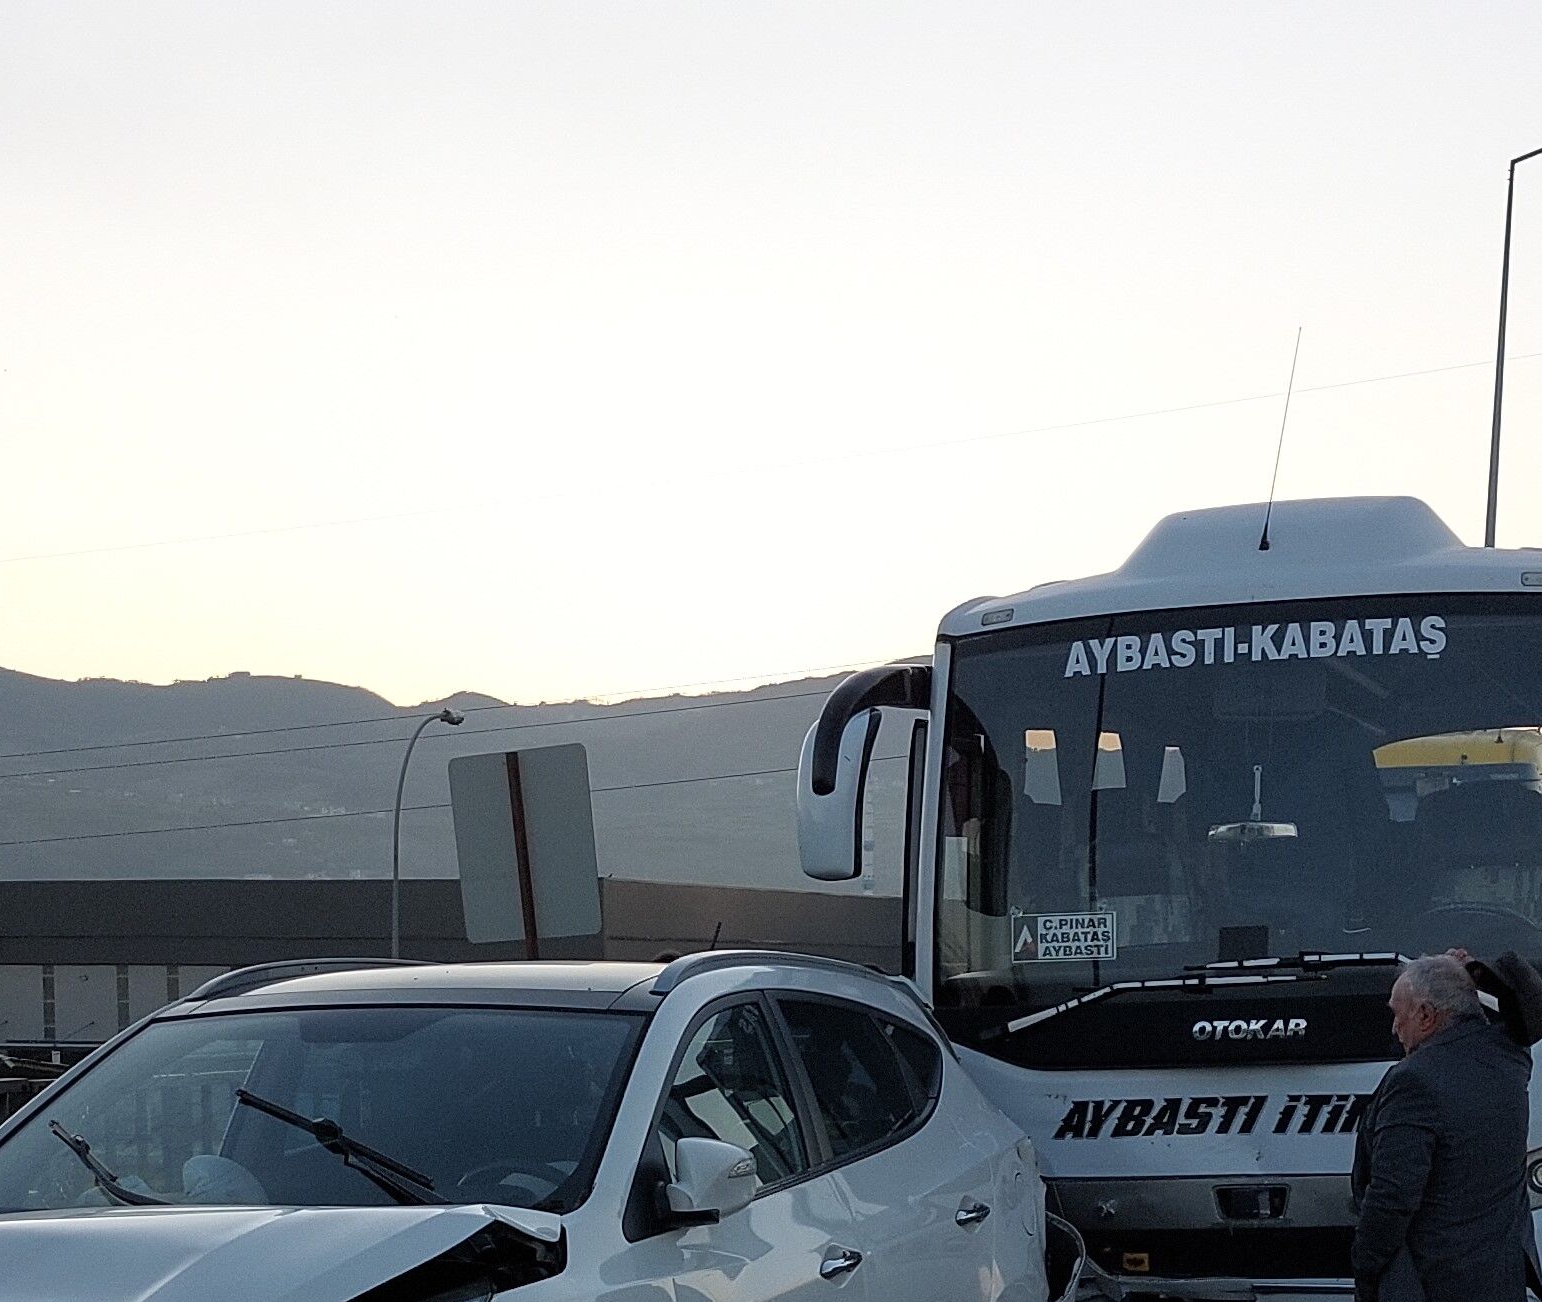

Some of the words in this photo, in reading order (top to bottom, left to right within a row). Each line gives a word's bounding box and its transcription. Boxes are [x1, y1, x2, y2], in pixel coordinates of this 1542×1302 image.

[1064, 615, 1448, 678] AYBASTI-KABATAŞ
[1192, 1018, 1308, 1041] OTOKAR
[1051, 1095, 1269, 1140] AYBASTI
